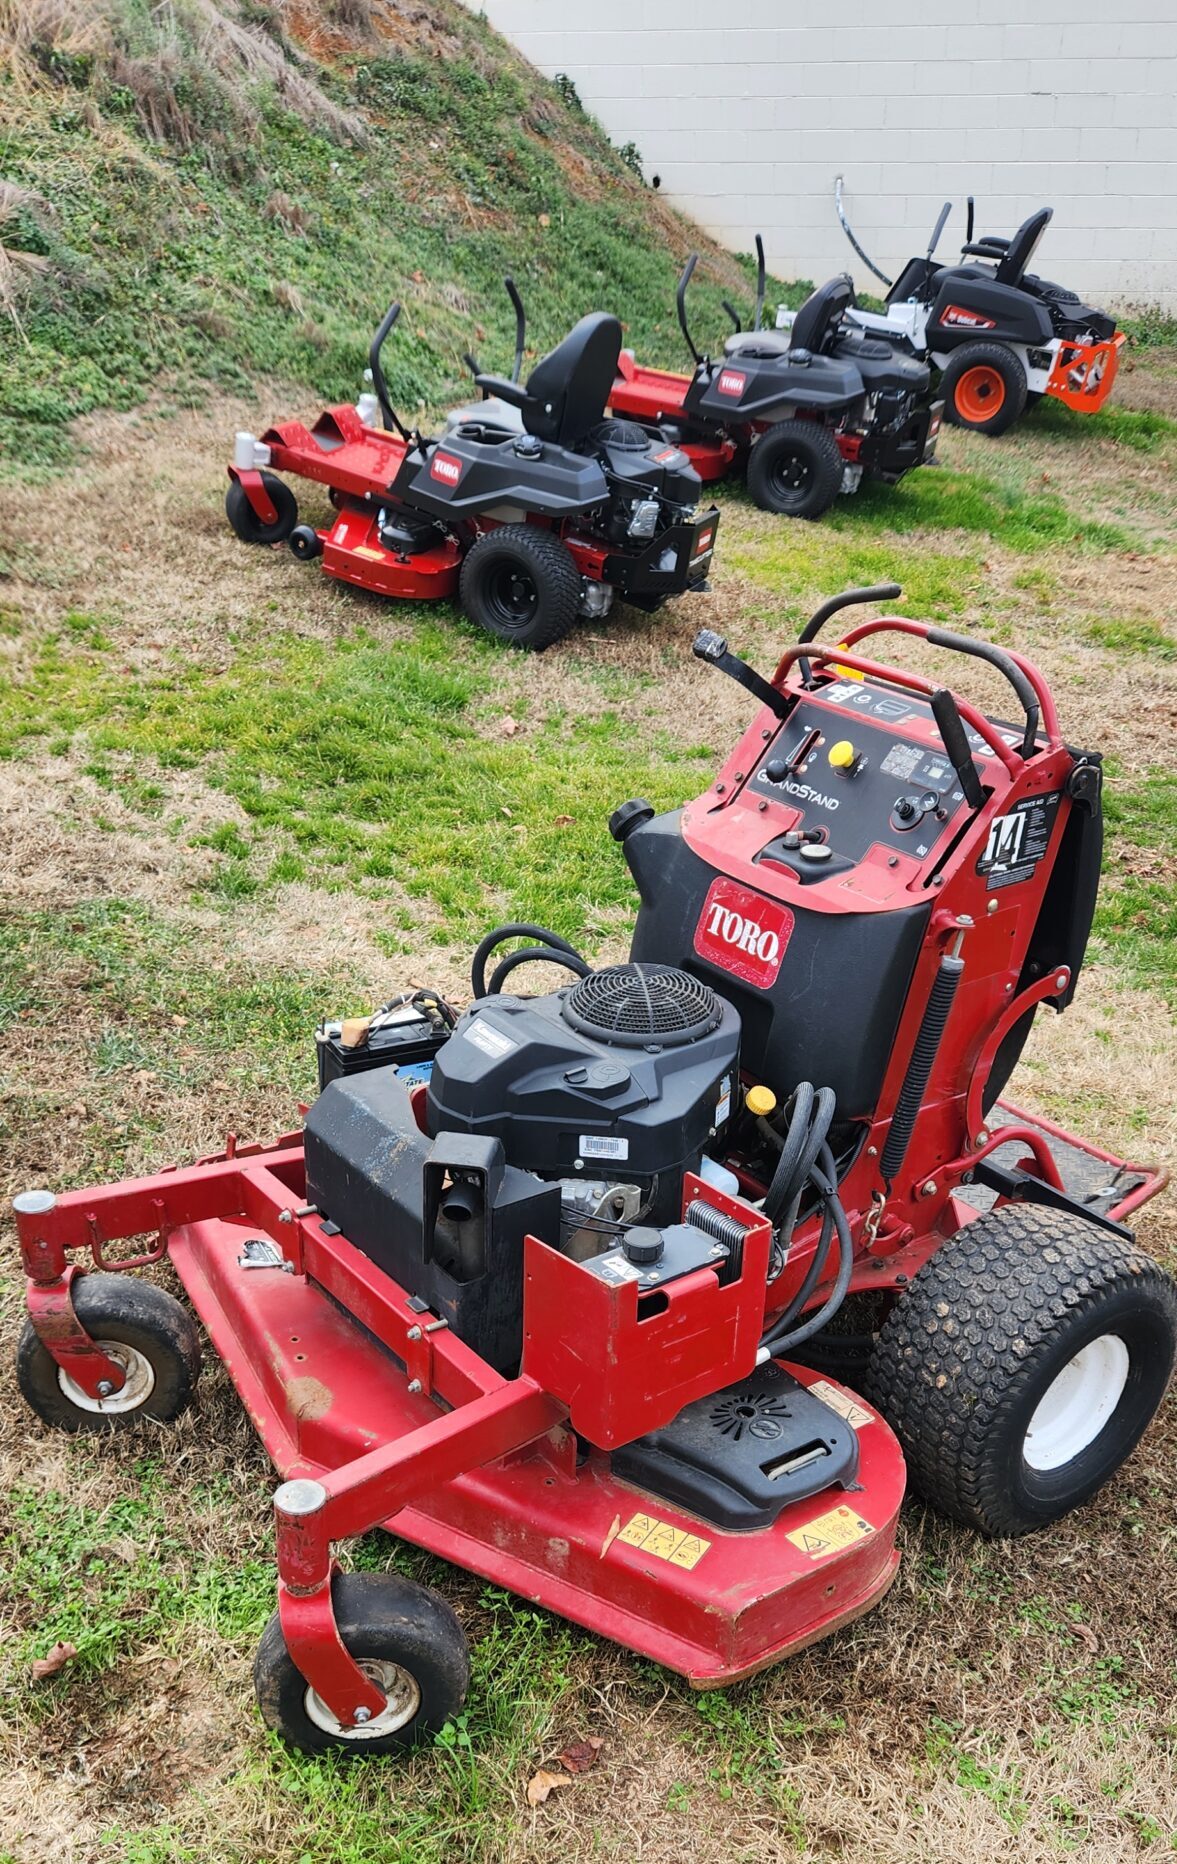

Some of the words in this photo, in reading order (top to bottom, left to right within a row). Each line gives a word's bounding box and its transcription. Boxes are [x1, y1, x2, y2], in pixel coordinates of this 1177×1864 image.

[720, 375, 743, 391] TORO
[434, 459, 459, 480] TORO
[707, 902, 779, 962] TORO
